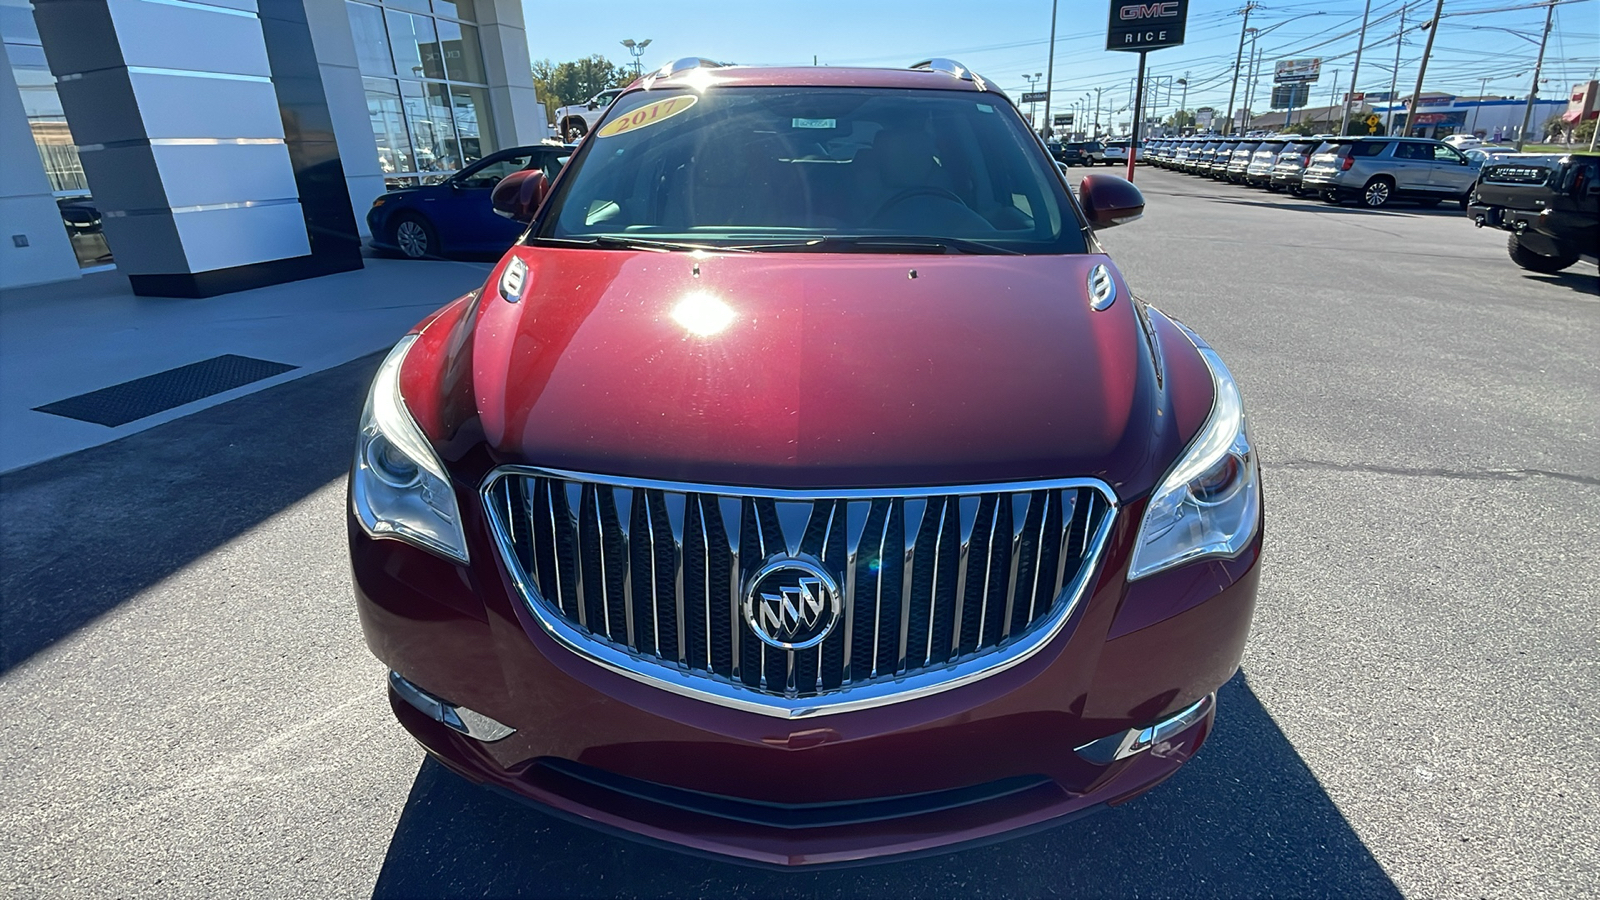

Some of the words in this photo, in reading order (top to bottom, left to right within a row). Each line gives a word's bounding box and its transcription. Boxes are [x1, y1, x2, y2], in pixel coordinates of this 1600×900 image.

[1120, 2, 1179, 20] GMC
[1125, 31, 1167, 43] RICE
[615, 99, 677, 133] 2017
